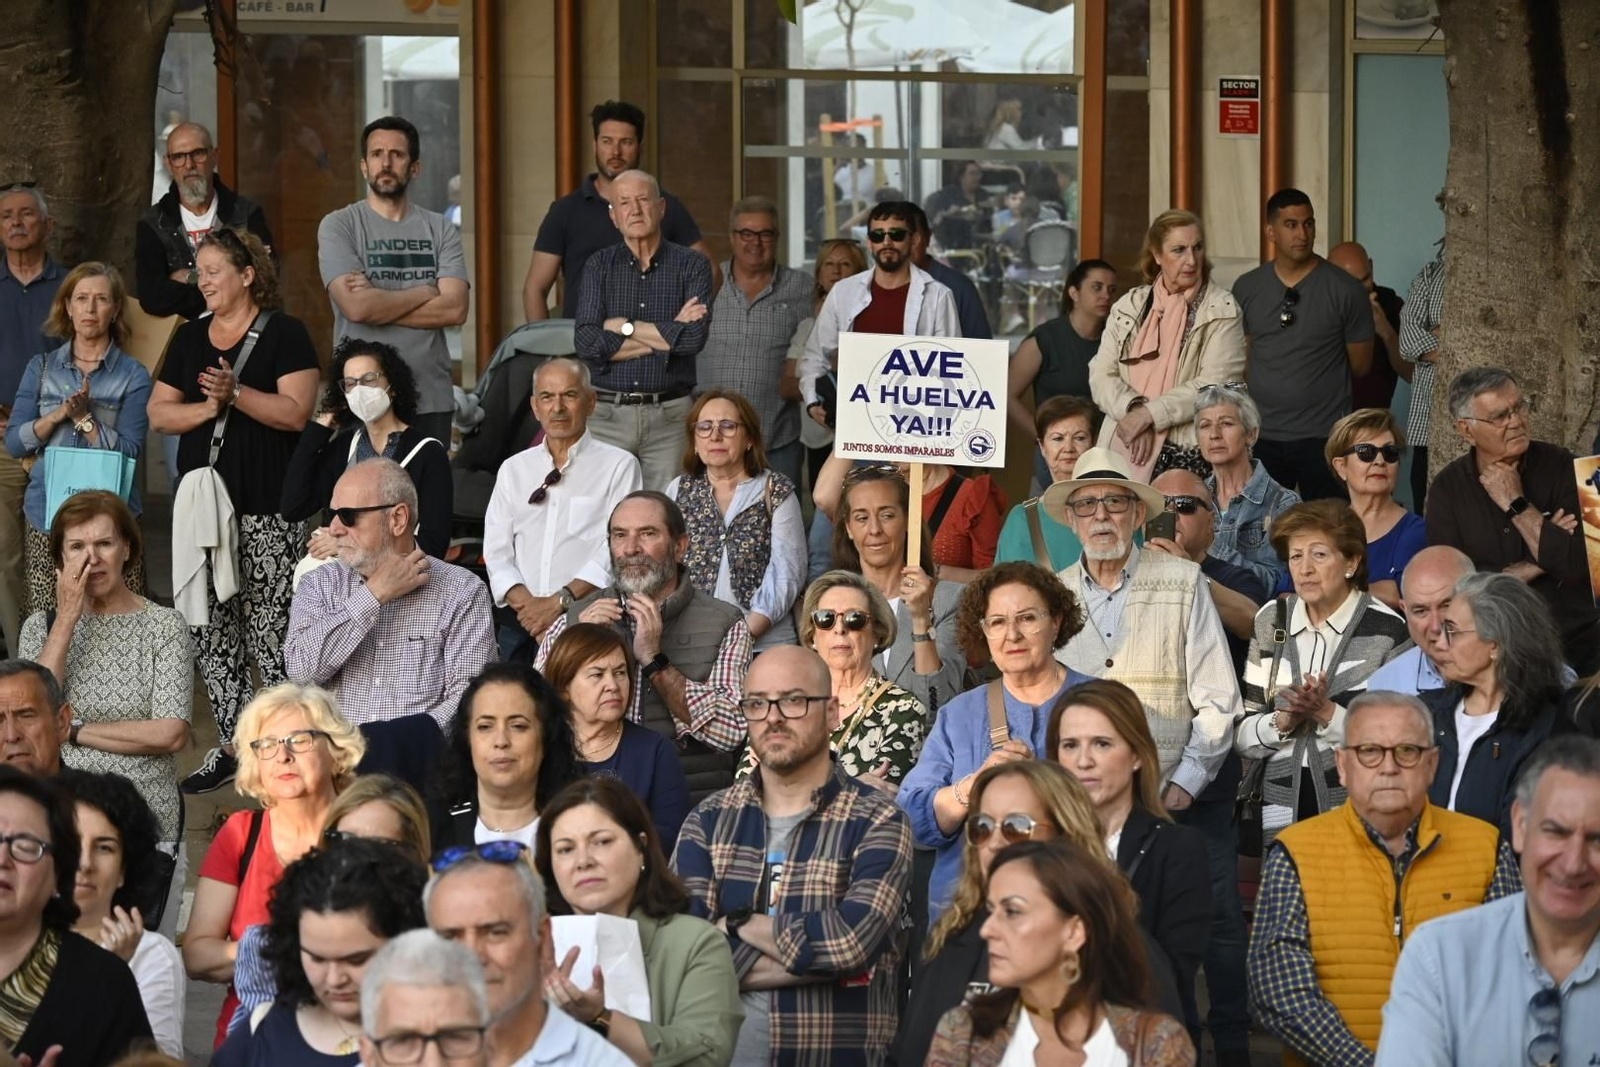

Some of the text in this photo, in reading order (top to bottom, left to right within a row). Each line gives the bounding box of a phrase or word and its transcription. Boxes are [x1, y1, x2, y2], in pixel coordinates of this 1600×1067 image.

[285, 2, 314, 13] BAR
[1222, 81, 1256, 89] SECTOR
[365, 239, 433, 251] UNDER
[370, 271, 436, 281] ARMOUR
[881, 348, 965, 379] AVE
[849, 383, 996, 410] A HUELVA
[890, 414, 951, 437] YA!!!
[843, 443, 955, 457] JUNTOS SOMOS IMPARABLES
